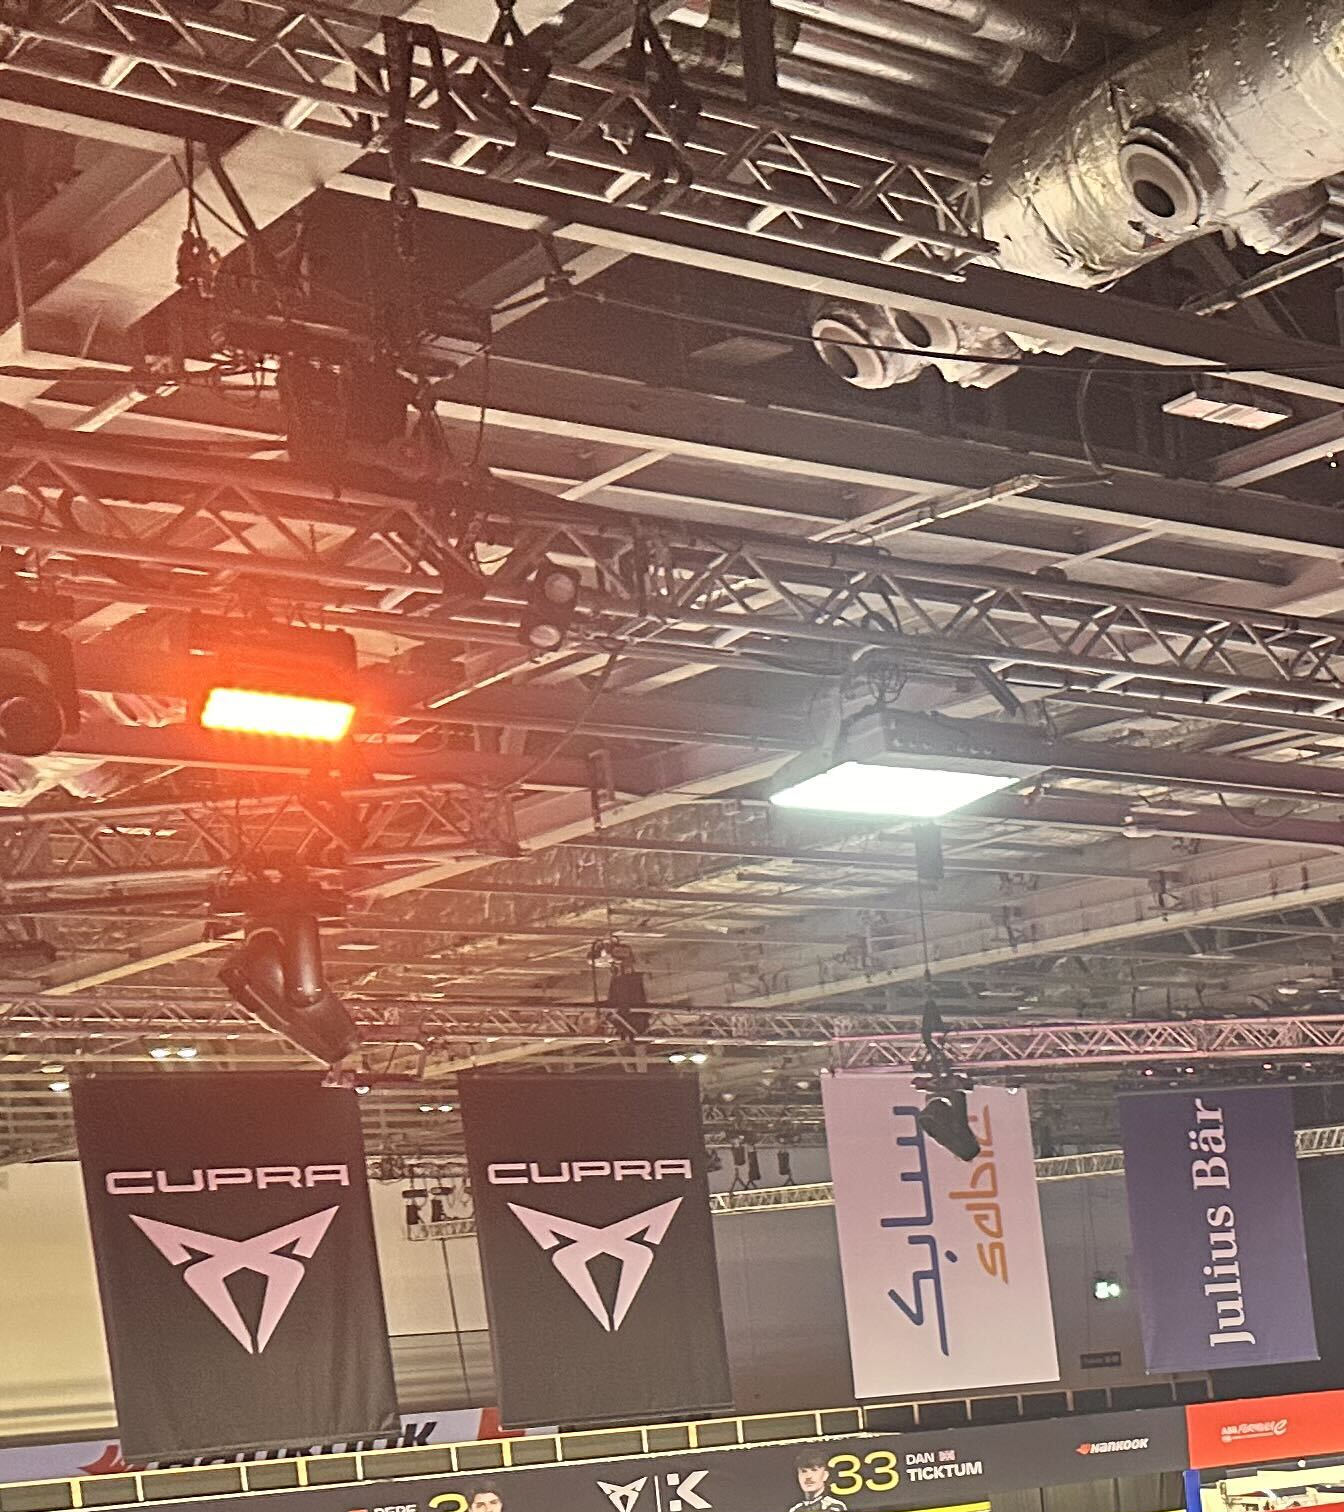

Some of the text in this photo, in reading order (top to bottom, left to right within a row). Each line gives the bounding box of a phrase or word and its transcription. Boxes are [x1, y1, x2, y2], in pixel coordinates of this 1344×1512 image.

[105, 1164, 350, 1195] CUPRA
[487, 1159, 692, 1185] CUPRA
[1189, 1098, 1257, 1348] Julius Bär
[828, 1451, 899, 1494] 33
[905, 1452, 935, 1465] DAN
[906, 1461, 983, 1482] TICKTUM
